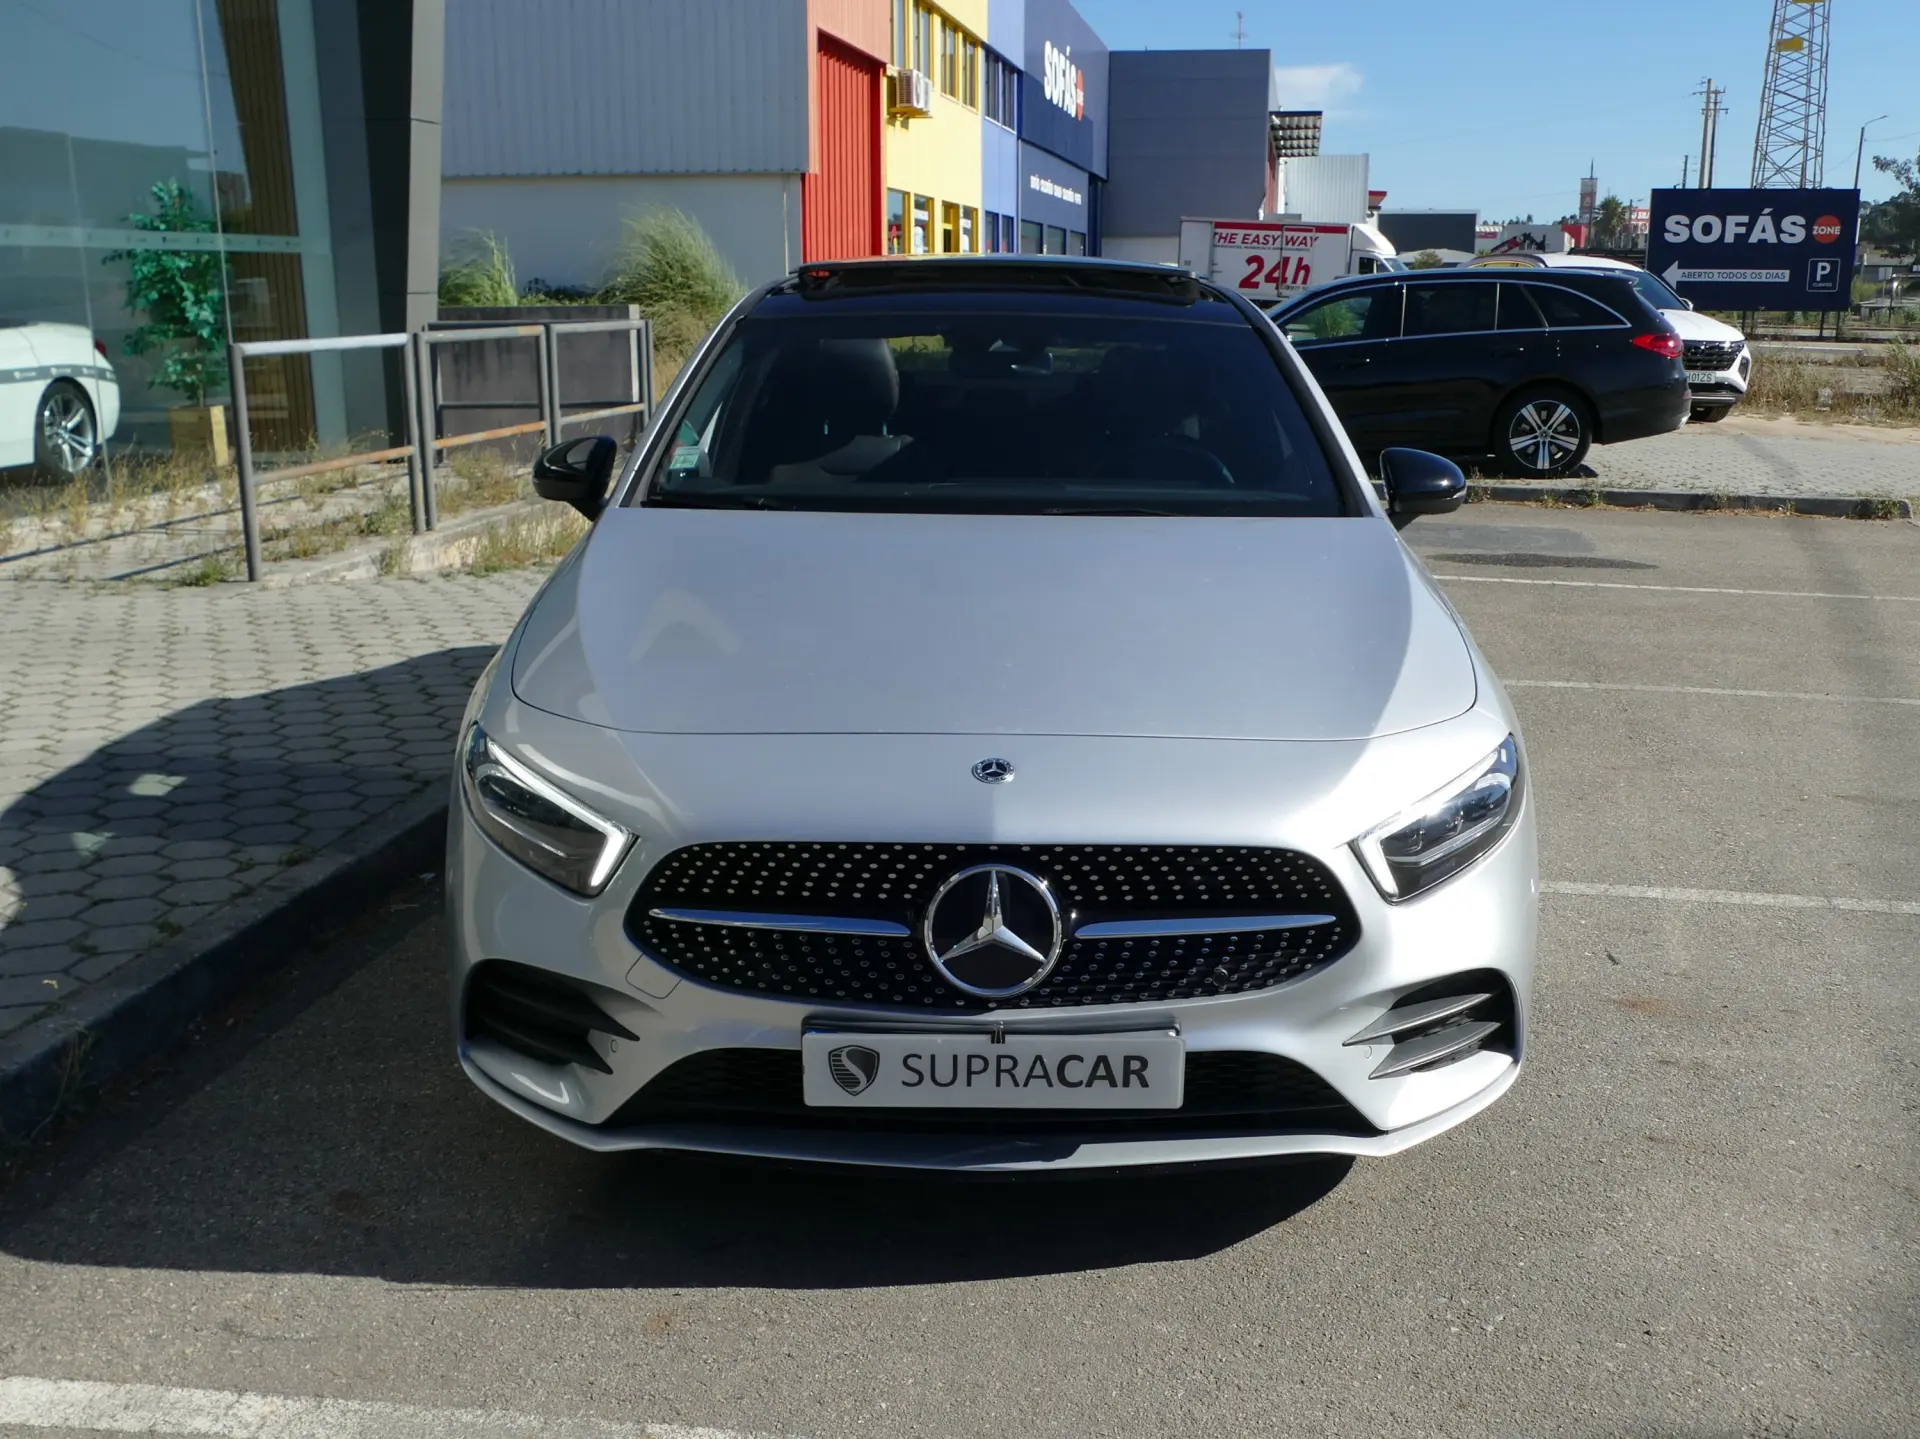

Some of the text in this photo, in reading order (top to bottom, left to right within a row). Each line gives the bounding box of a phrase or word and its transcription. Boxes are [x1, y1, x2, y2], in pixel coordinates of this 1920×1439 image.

[1044, 40, 1077, 118] SOFÁS
[1213, 231, 1239, 244] THE
[1241, 233, 1281, 246] EASY
[1284, 235, 1320, 248] WAY
[1663, 208, 1806, 244] SOFÁS
[1812, 225, 1841, 235] ZONE
[1238, 254, 1311, 290] 24h
[1681, 271, 1786, 280] ABERTO TODOS OS DIAS
[1816, 262, 1831, 281] P
[901, 1053, 1150, 1089] SUPRACAR
